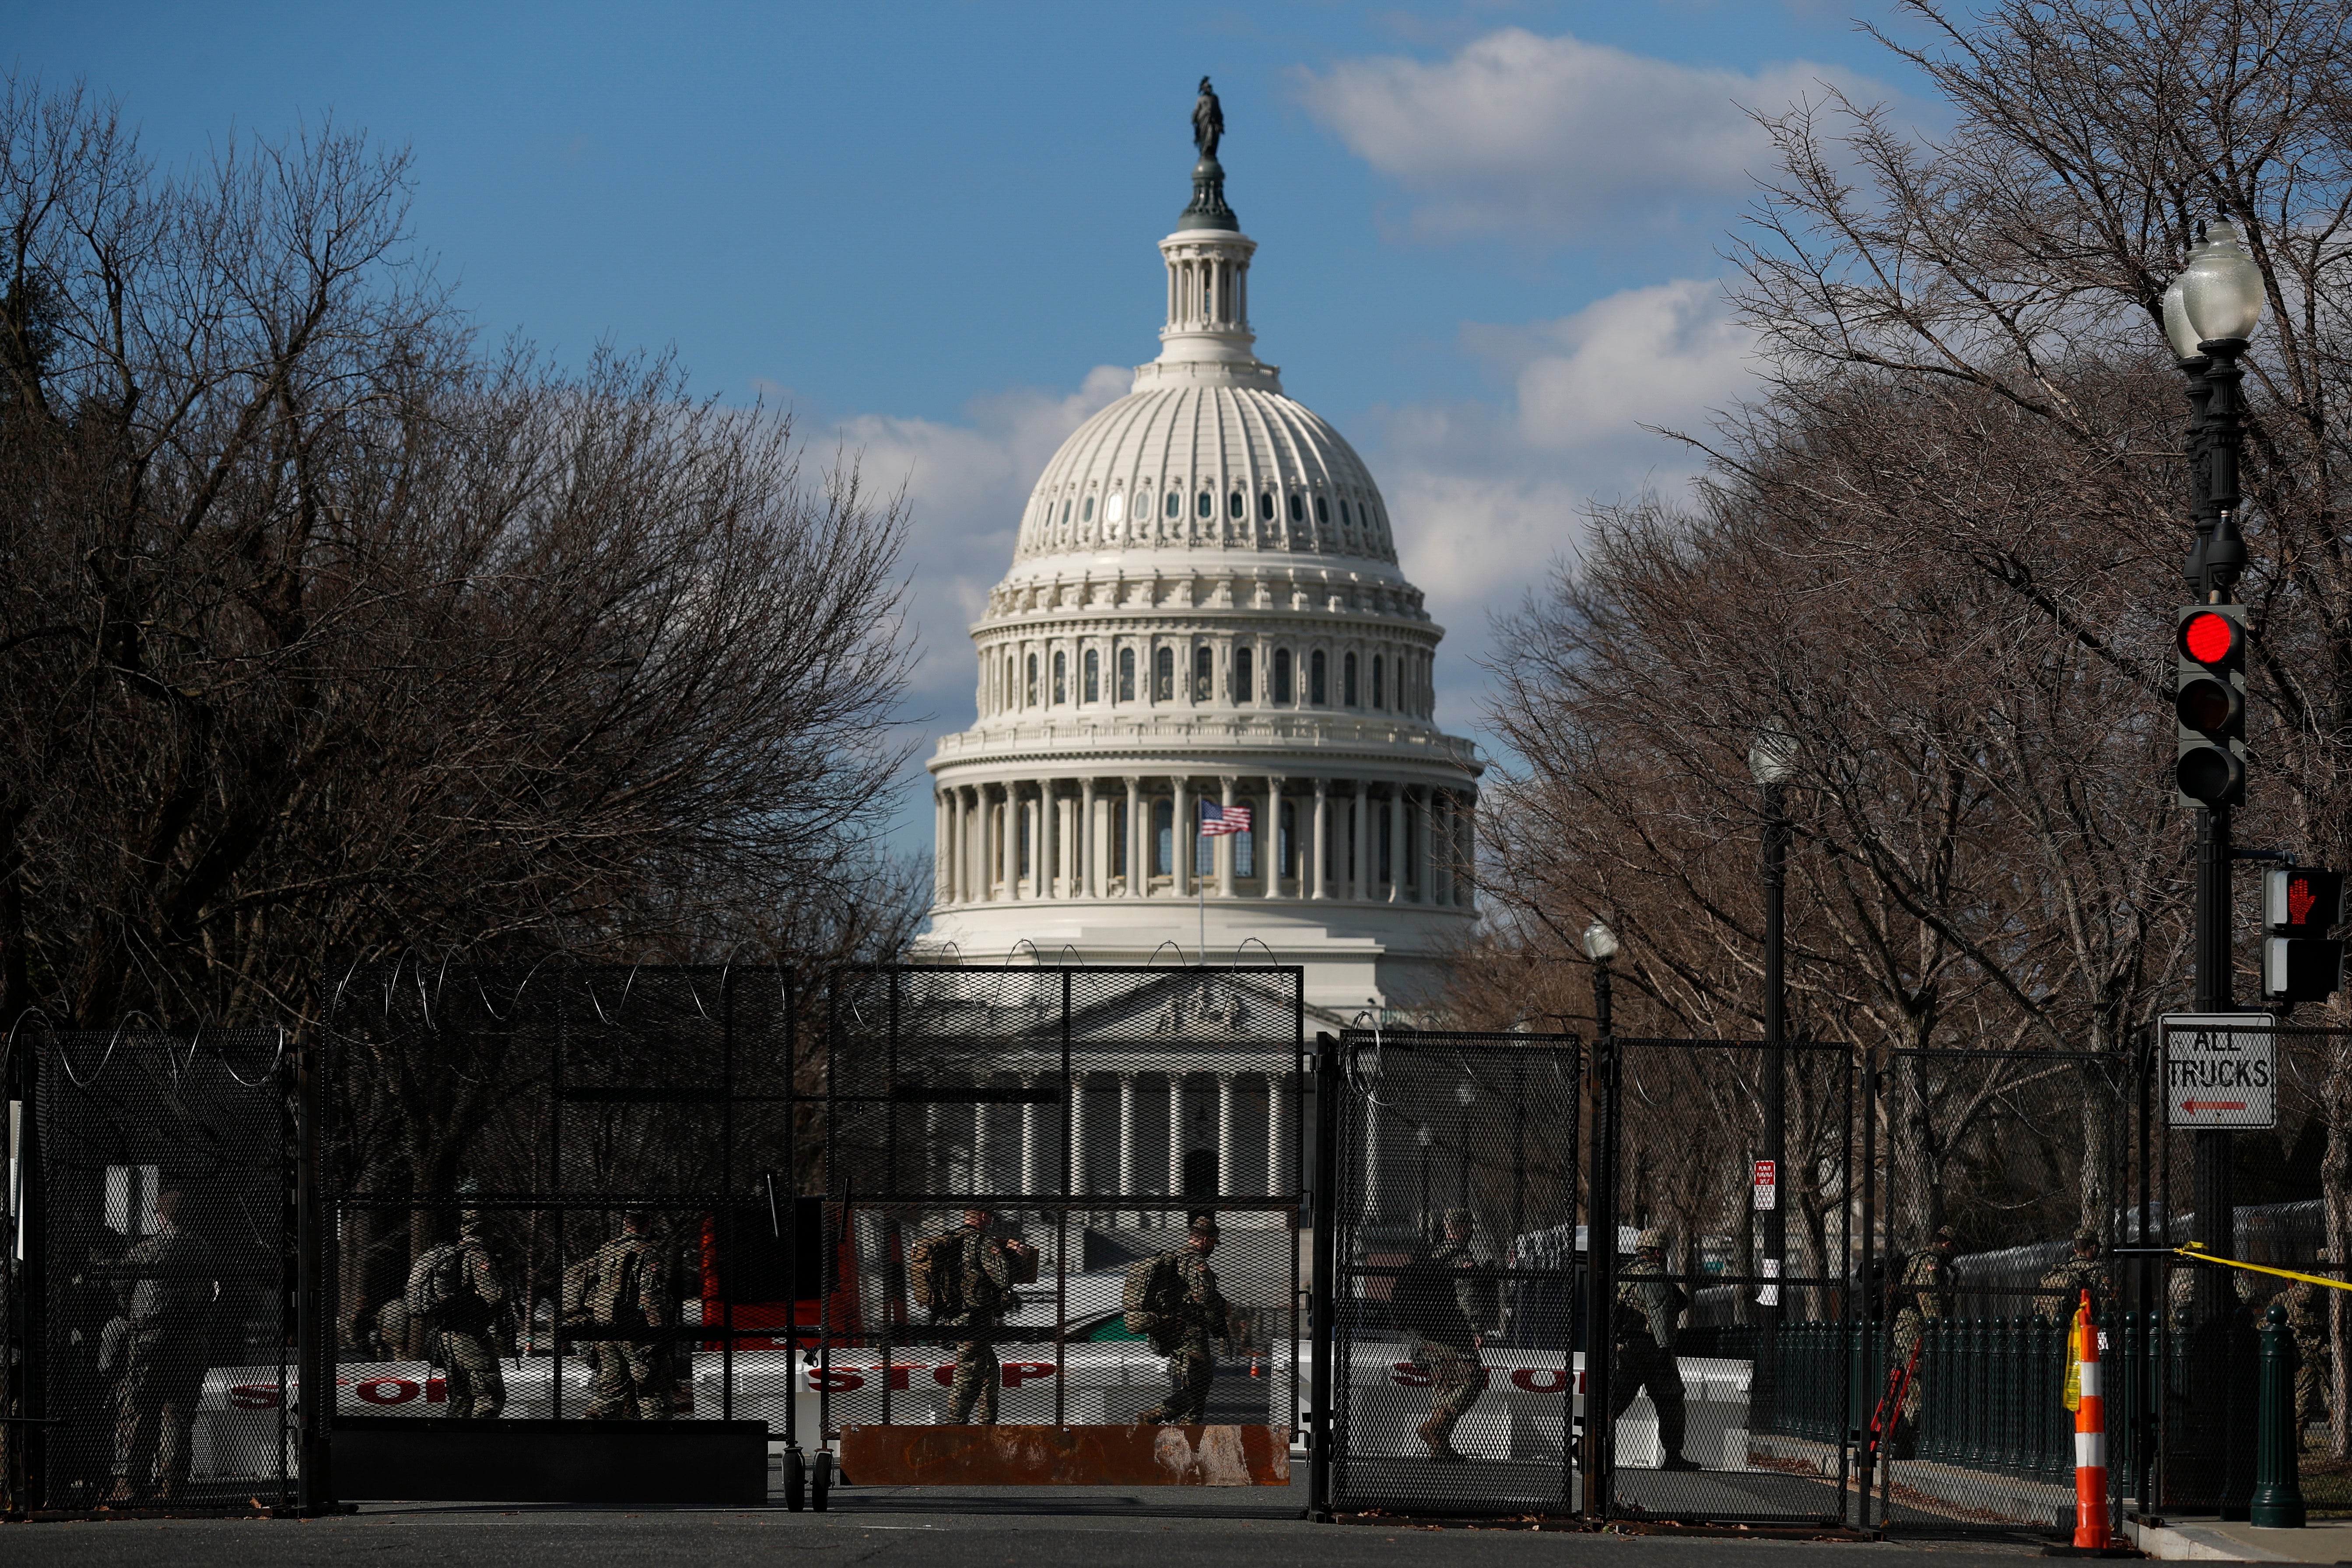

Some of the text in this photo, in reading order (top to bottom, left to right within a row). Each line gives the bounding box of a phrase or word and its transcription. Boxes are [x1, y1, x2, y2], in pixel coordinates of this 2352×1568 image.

[2194, 1024, 2241, 1052] ALL
[2168, 1059, 2269, 1087] TRUCKS
[1392, 1362, 1585, 1393] SO
[232, 1377, 446, 1409] SO
